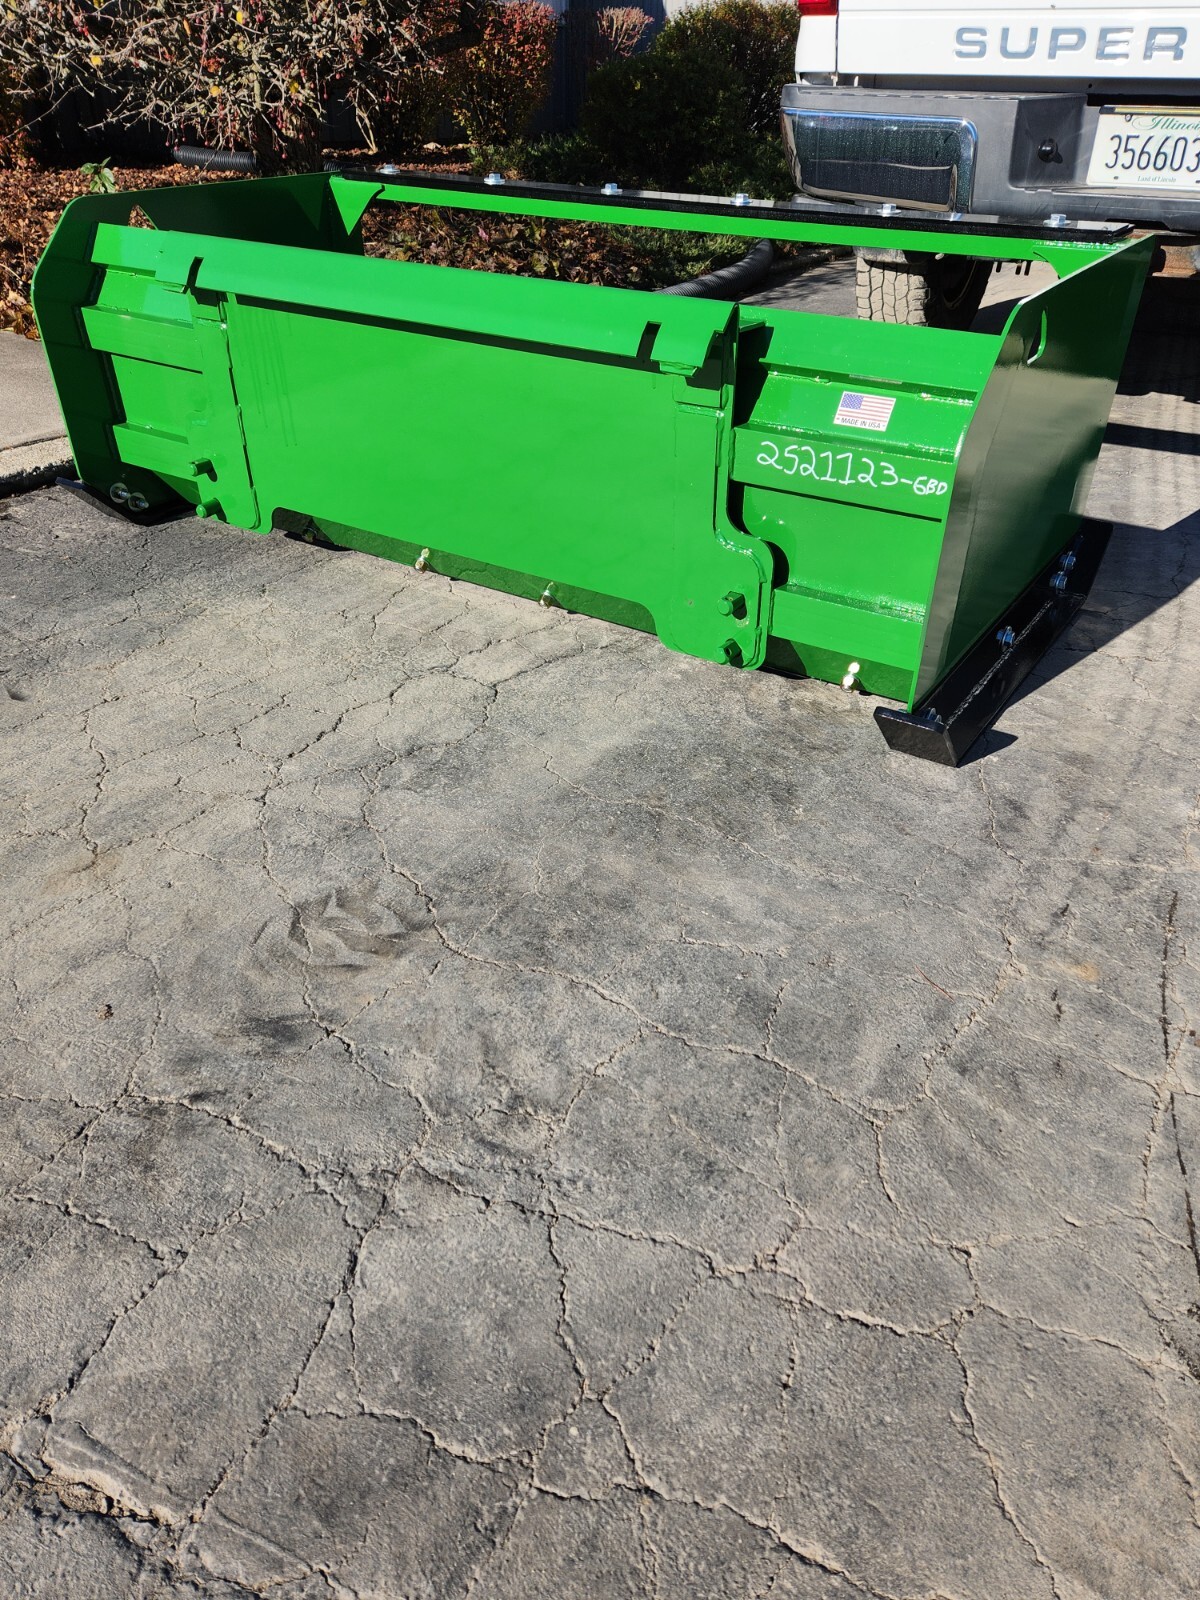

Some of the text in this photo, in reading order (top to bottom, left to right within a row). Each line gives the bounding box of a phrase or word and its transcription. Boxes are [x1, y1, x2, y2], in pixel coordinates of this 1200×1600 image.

[954, 27, 1188, 61] SUPER
[1132, 115, 1200, 130] Illinoi
[841, 417, 859, 426] MADE
[868, 421, 881, 429] USA
